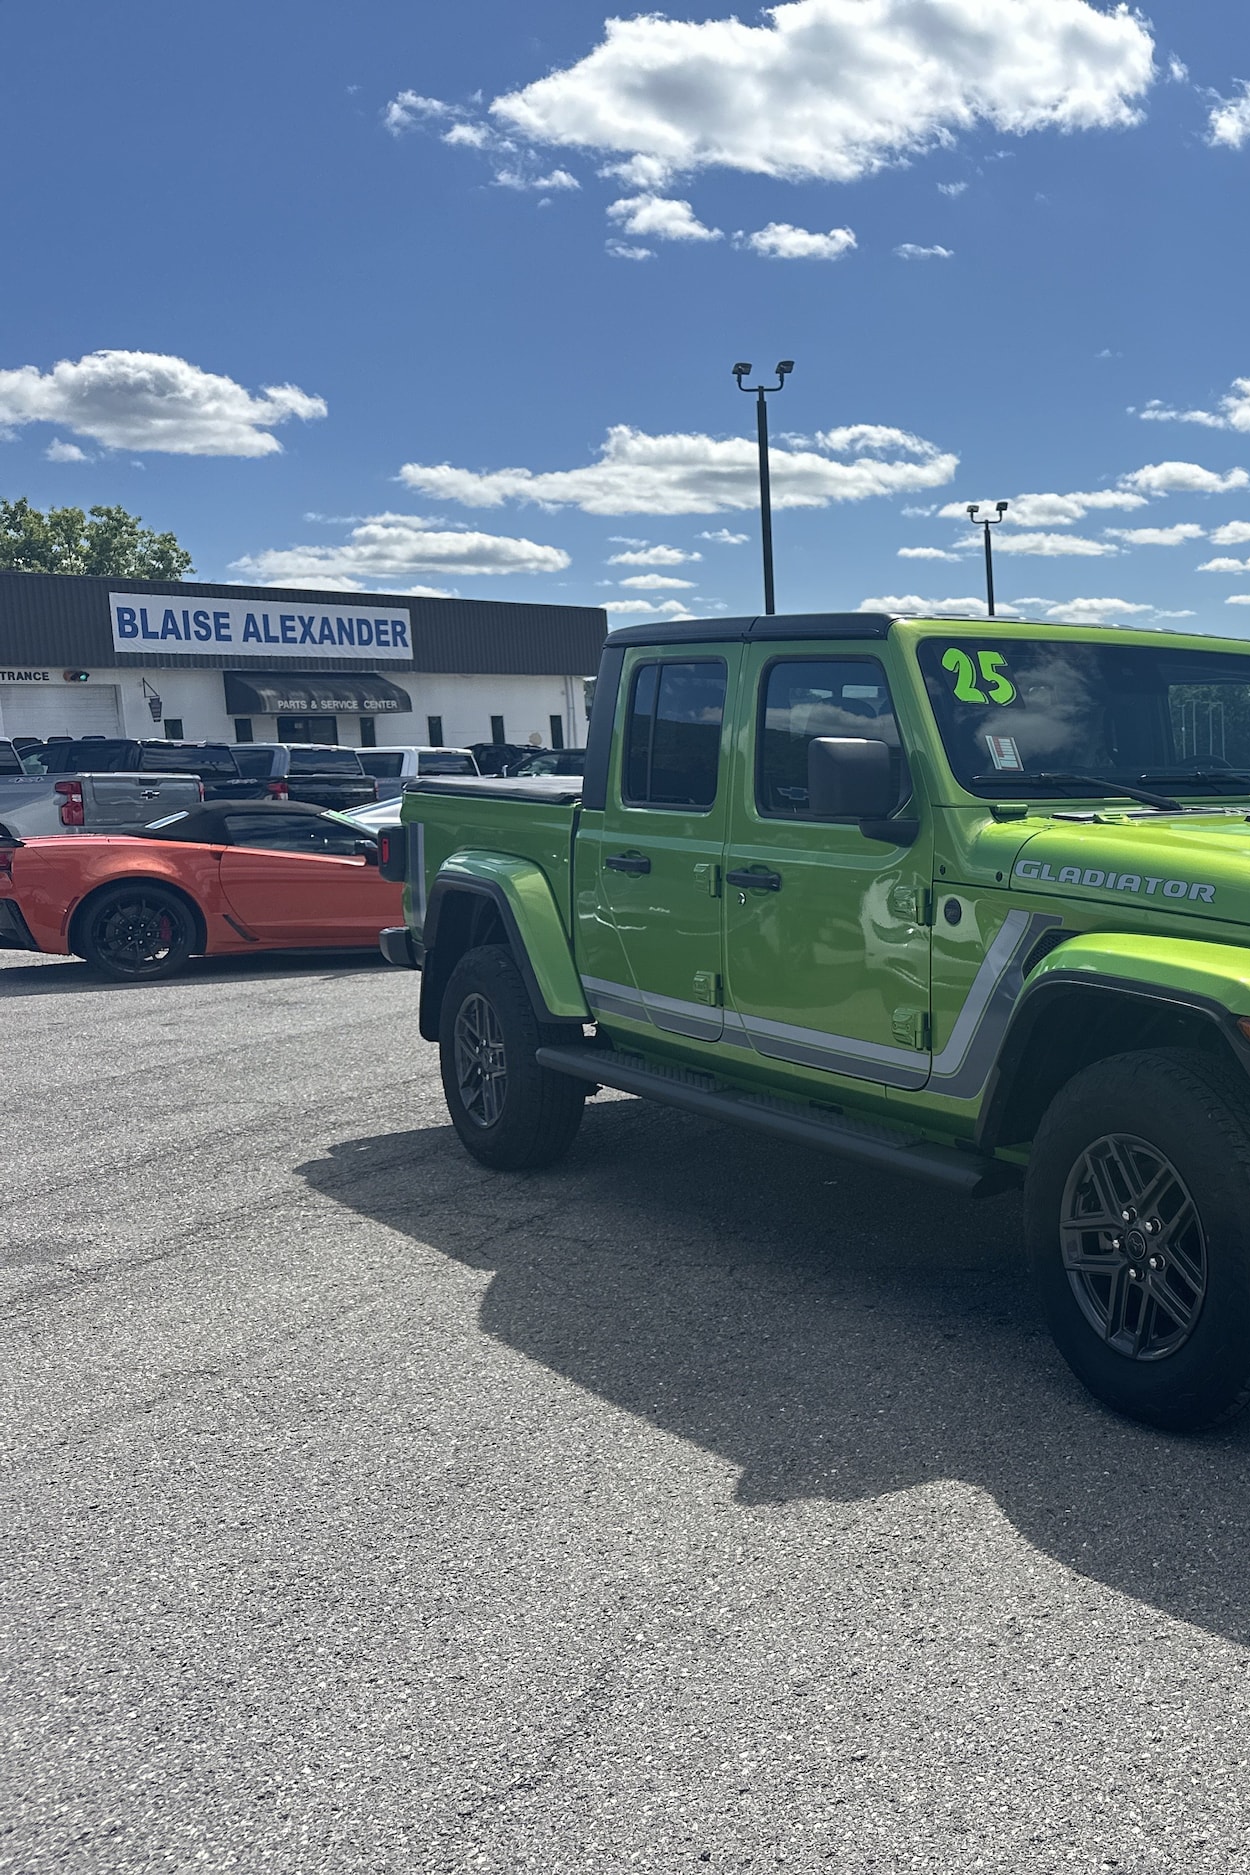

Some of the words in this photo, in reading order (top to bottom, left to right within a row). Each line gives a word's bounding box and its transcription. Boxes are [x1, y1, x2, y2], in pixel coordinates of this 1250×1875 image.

[116, 606, 232, 642] BLAISE
[242, 613, 409, 648] ALEXANDER
[941, 647, 1018, 707] 25
[278, 700, 307, 710] PARTS
[311, 700, 318, 710] &
[321, 700, 359, 710] SERVICE
[364, 700, 398, 710] CENTER
[1014, 859, 1216, 903] GLADIATOR
